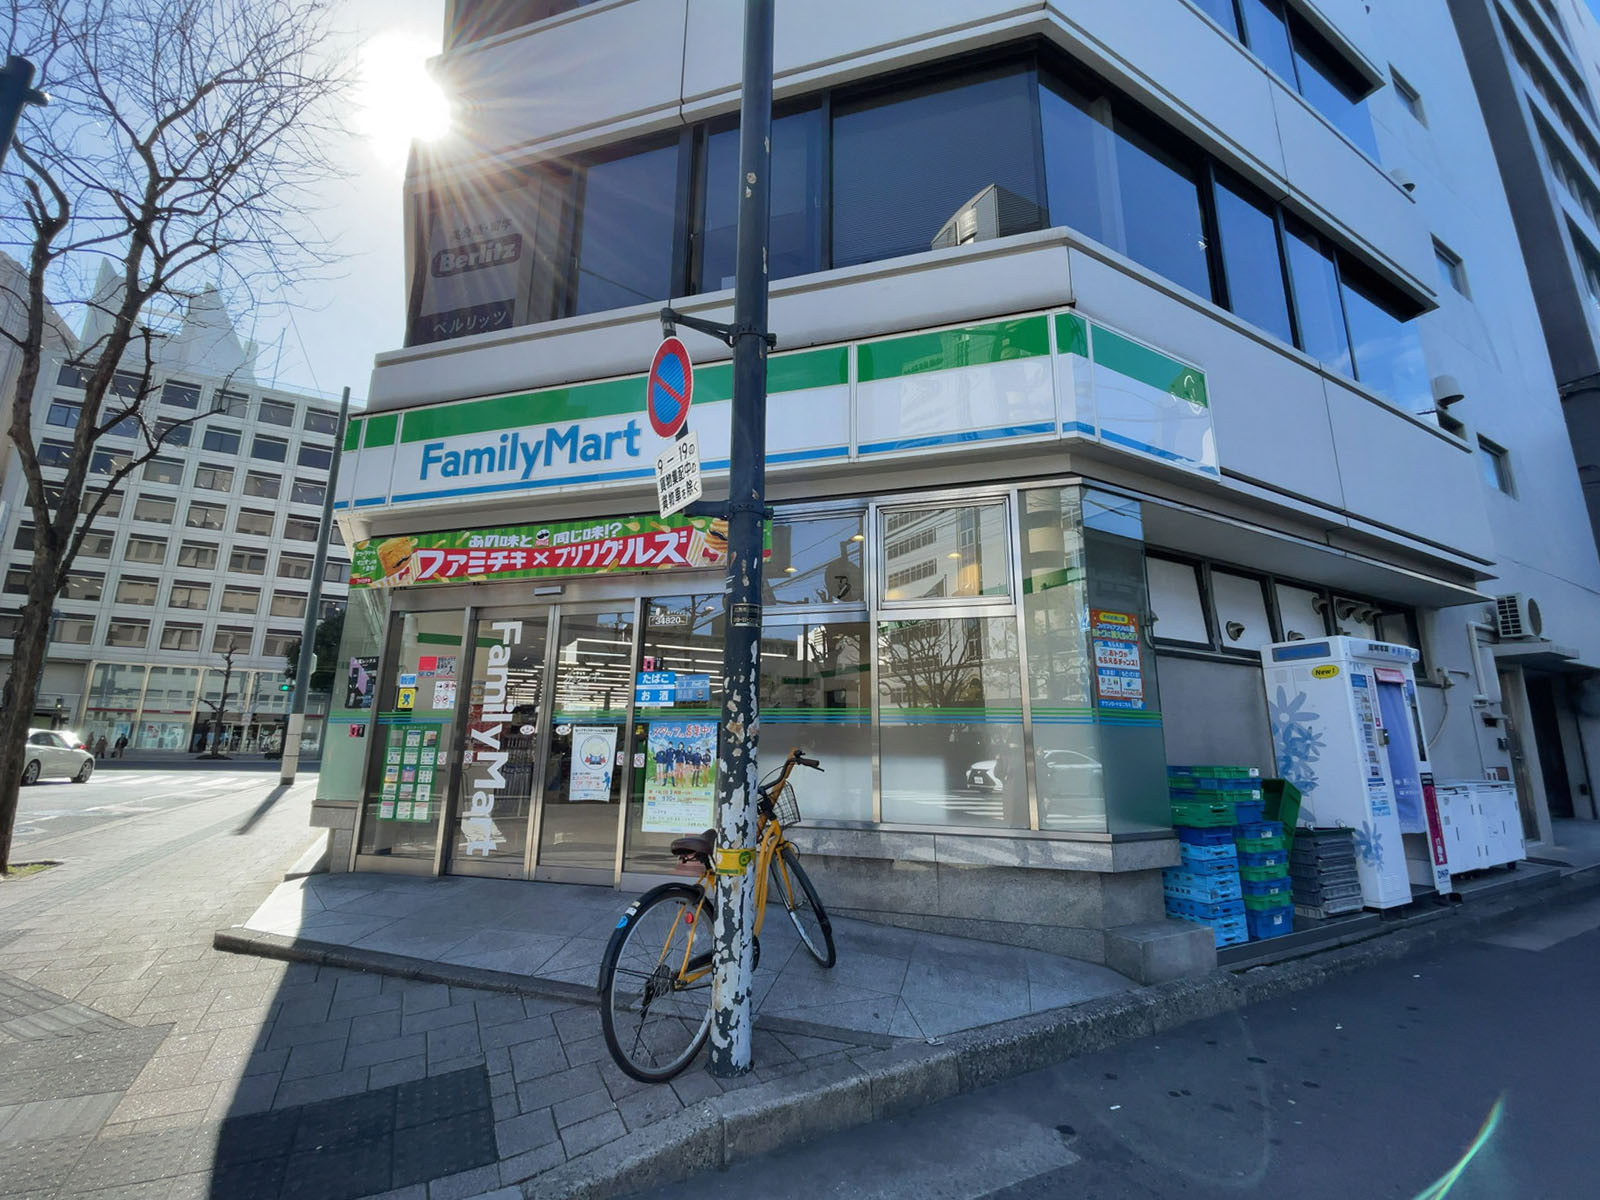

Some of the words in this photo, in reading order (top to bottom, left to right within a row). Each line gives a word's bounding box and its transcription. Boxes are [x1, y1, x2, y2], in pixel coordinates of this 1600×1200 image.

[440, 241, 515, 272] Berlitz
[433, 311, 507, 334] ベルリッツ
[419, 418, 641, 481] FamilyMart
[418, 550, 527, 579] ファミチキ
[555, 530, 688, 567] プリングルズ
[468, 534, 533, 548] あの味と
[655, 616, 681, 625] 34820
[642, 673, 669, 684] たばこ
[465, 620, 523, 857] FamilyMart
